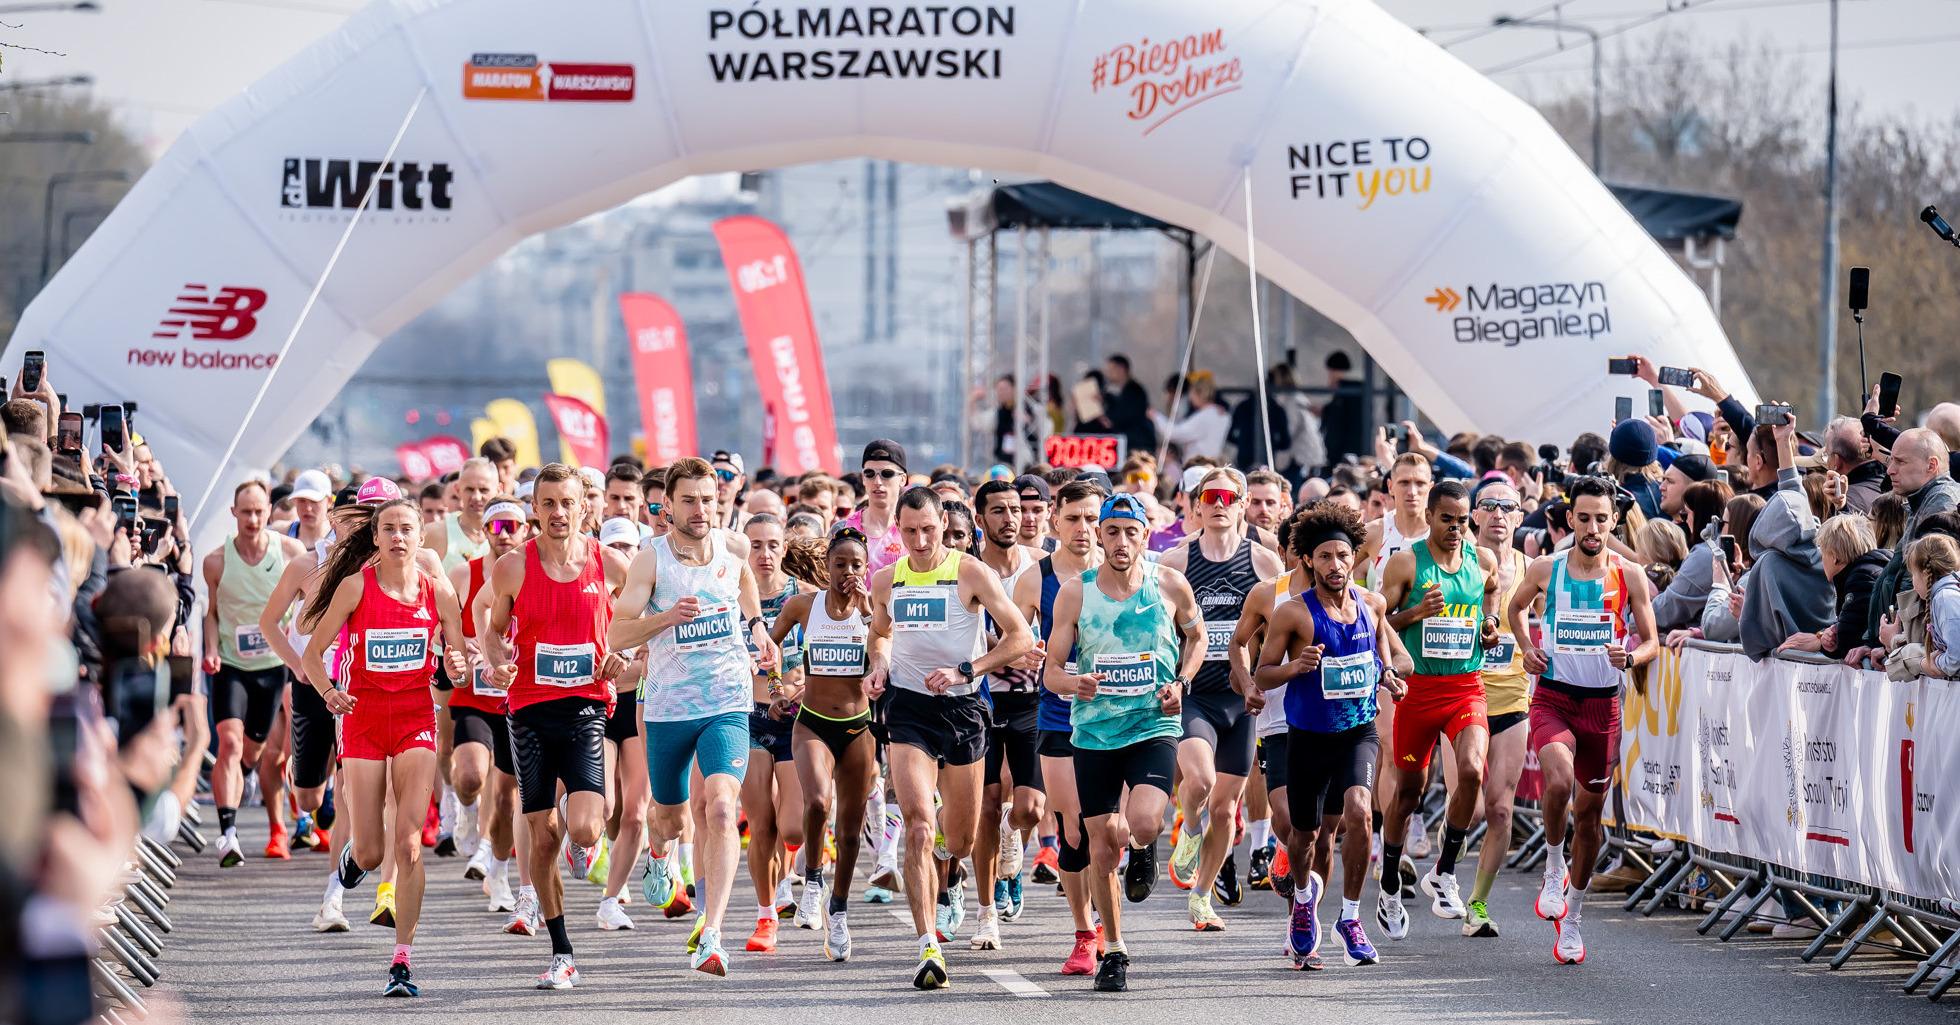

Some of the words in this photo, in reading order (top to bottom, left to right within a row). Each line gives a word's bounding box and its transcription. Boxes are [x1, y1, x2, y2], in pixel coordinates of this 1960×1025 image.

[709, 0, 1015, 40] PÓŁMARATON
[708, 49, 1001, 82] WARSZAWSKI
[1091, 28, 1227, 93] #Biegam
[472, 72, 532, 88] MARATON
[553, 74, 632, 91] WARSZAWSKI
[1288, 140, 1372, 170] NICE
[1382, 137, 1431, 163] TO
[304, 158, 454, 210] Witt
[1291, 172, 1350, 200] FIT
[1355, 166, 1433, 211] you
[1466, 281, 1607, 314] Magazyn
[1452, 306, 1612, 347] Bieganie.pl
[128, 348, 176, 367] new
[906, 603, 929, 617] M11
[1201, 595, 1237, 606] GRINDERS
[678, 618, 730, 639] NOWICKI
[1558, 628, 1611, 640] BOUQUANTAR
[1426, 632, 1473, 645] OUKHELFEN
[372, 643, 421, 659] OLEJARZ
[812, 648, 860, 662] MEDUGU
[553, 660, 578, 674] M12
[1340, 669, 1365, 686] M10
